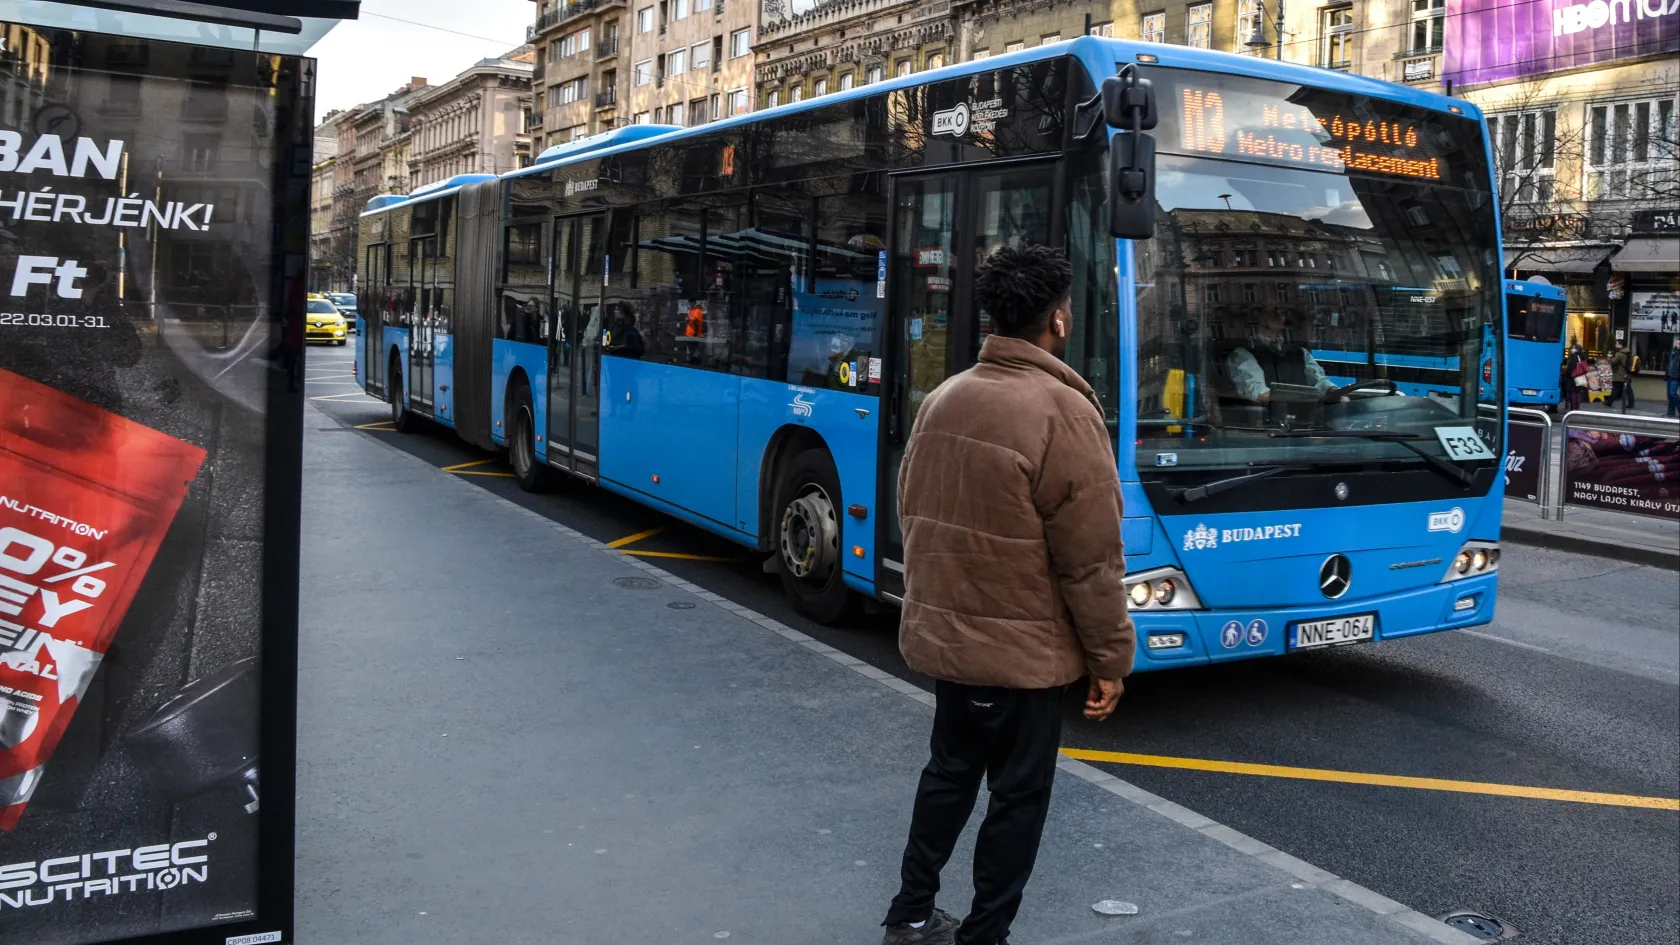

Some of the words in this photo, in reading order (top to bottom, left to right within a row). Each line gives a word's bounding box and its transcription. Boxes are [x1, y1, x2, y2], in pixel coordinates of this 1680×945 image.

[972, 98, 1003, 111] BUDAPESTI
[937, 115, 953, 128] BKK
[1183, 88, 1226, 154] M3
[1238, 131, 1304, 161] Metro
[1307, 144, 1440, 180] replacement
[10, 254, 87, 299] Ft
[1445, 436, 1484, 457] F33
[1574, 481, 1592, 491] 1149
[1573, 491, 1598, 502] NAGY
[1600, 495, 1628, 506] LAJOS
[1630, 498, 1662, 511] KIRÁLY
[1433, 517, 1449, 526] BKK
[1221, 523, 1303, 543] BUDAPEST
[1300, 617, 1370, 645] NNE-064
[13, 690, 44, 702] ACIDS
[252, 934, 276, 943] 04471
